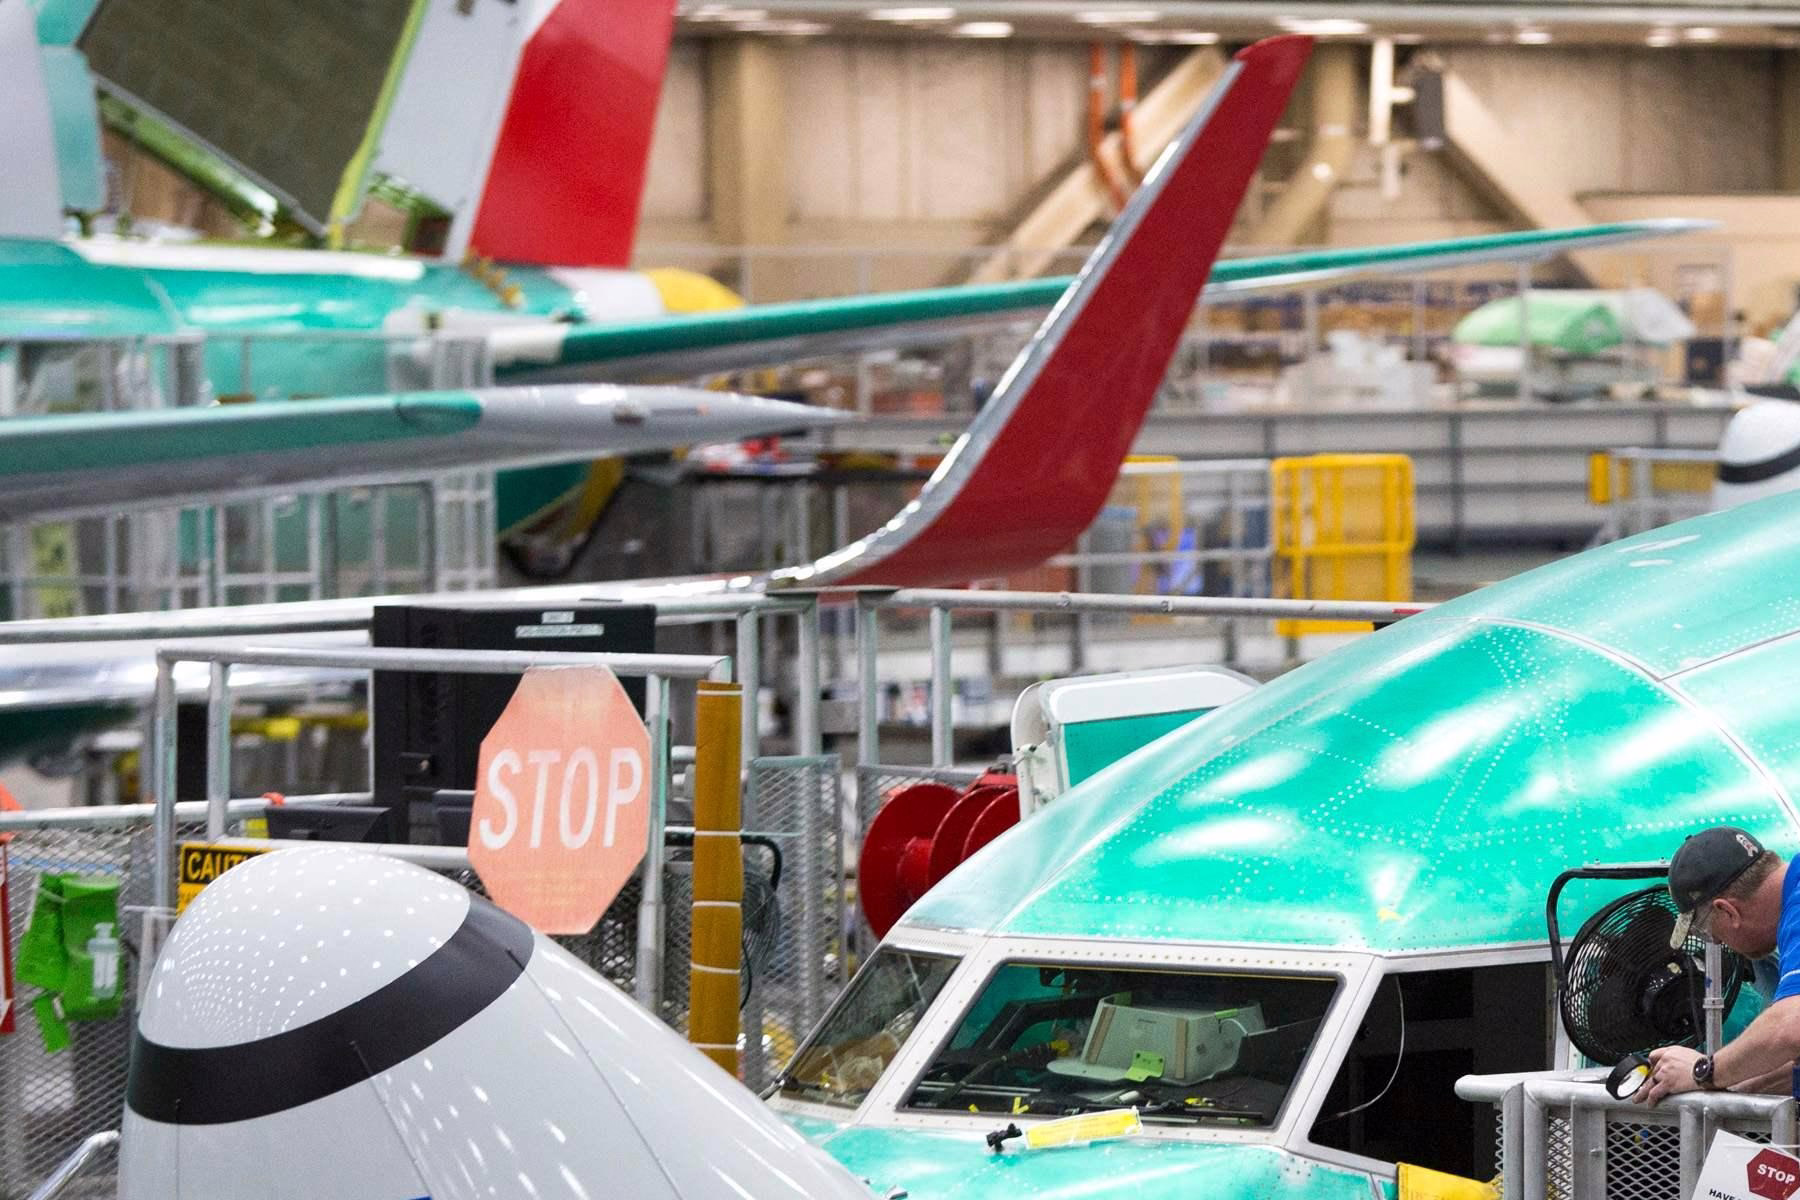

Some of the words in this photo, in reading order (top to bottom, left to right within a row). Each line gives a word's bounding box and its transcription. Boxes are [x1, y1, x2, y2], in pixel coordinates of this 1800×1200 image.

[479, 747, 643, 849] STOP
[187, 851, 247, 880] CAUT
[1757, 1164, 1796, 1185] STOP
